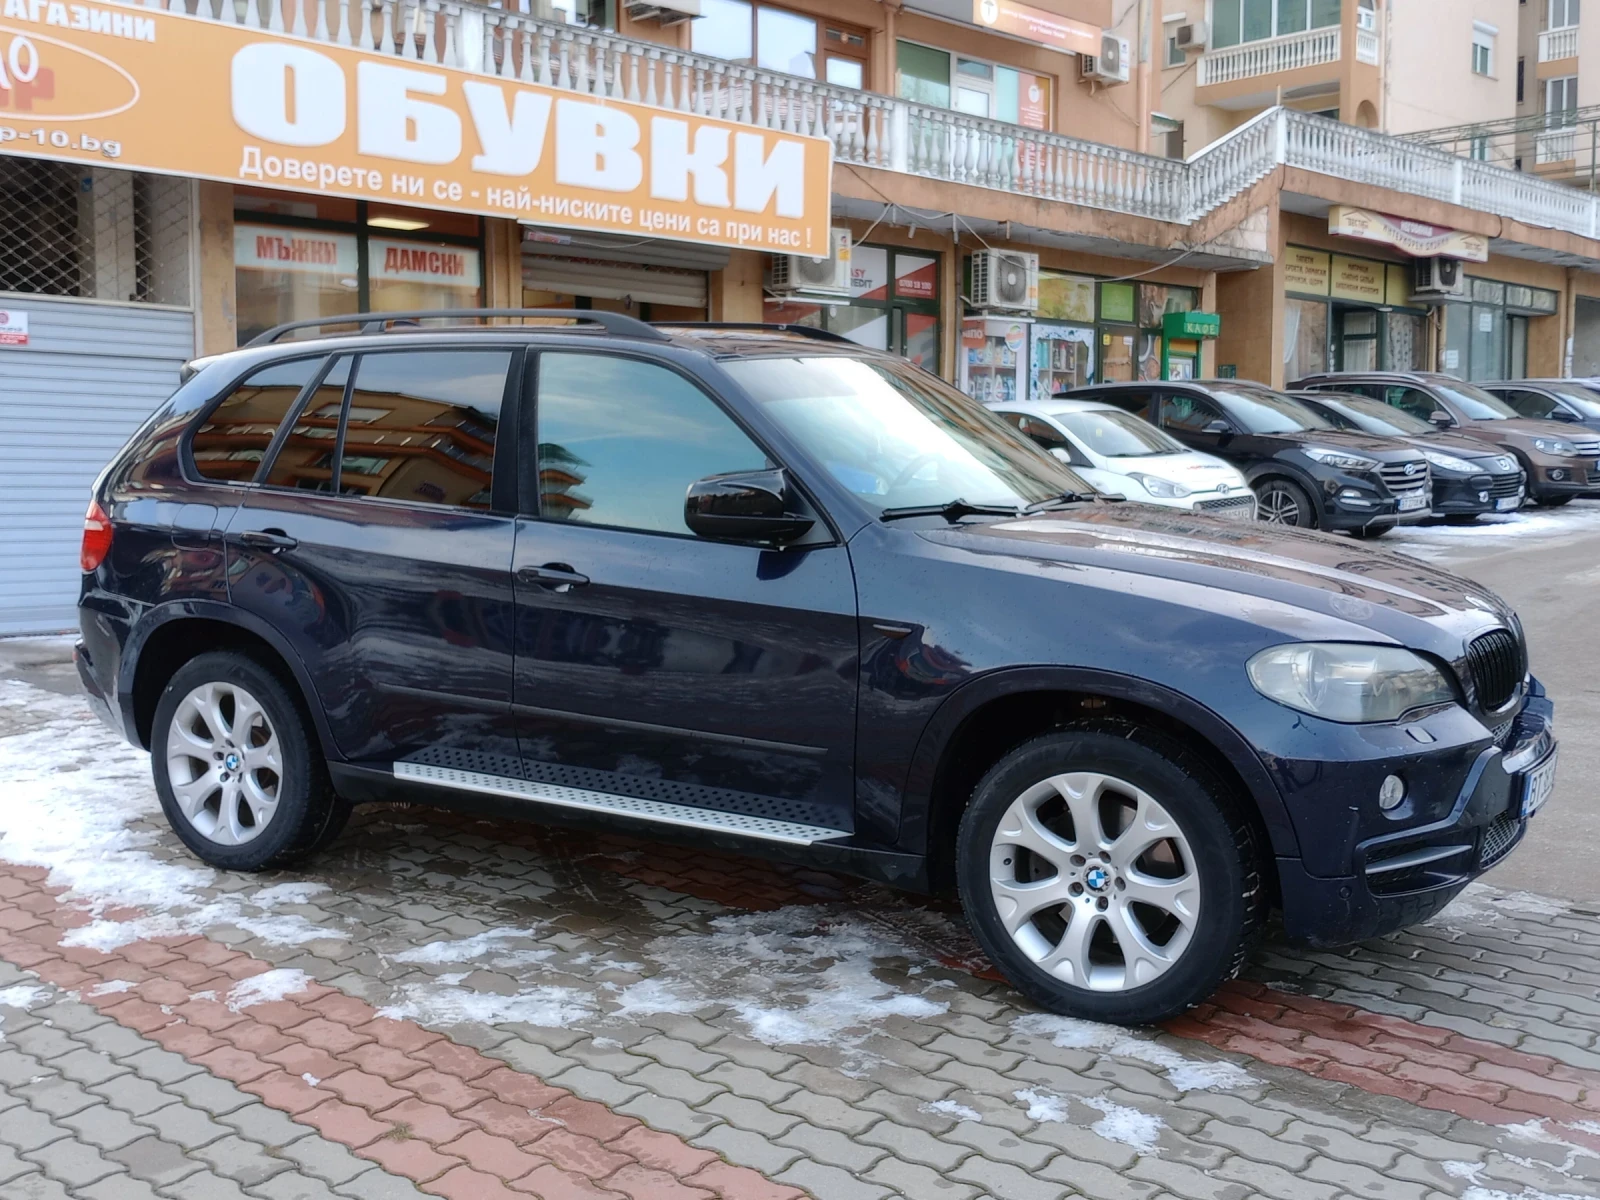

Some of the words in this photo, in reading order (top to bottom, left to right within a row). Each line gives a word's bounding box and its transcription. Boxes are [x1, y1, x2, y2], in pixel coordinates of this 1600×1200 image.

[0, 0, 156, 43] АГАЗИНИ
[231, 42, 805, 219] ОБУВКИ
[239, 145, 383, 191] Доверете
[391, 173, 425, 198] ни
[432, 179, 463, 202] се
[486, 186, 633, 225] най-ниските
[639, 208, 692, 239] цени
[696, 216, 720, 238] са
[725, 224, 763, 250] при
[768, 226, 802, 249] нас
[255, 235, 338, 265] МЪЖКИ
[384, 247, 465, 277] ДАМСКИ
[1187, 323, 1216, 335] КАФЕ
